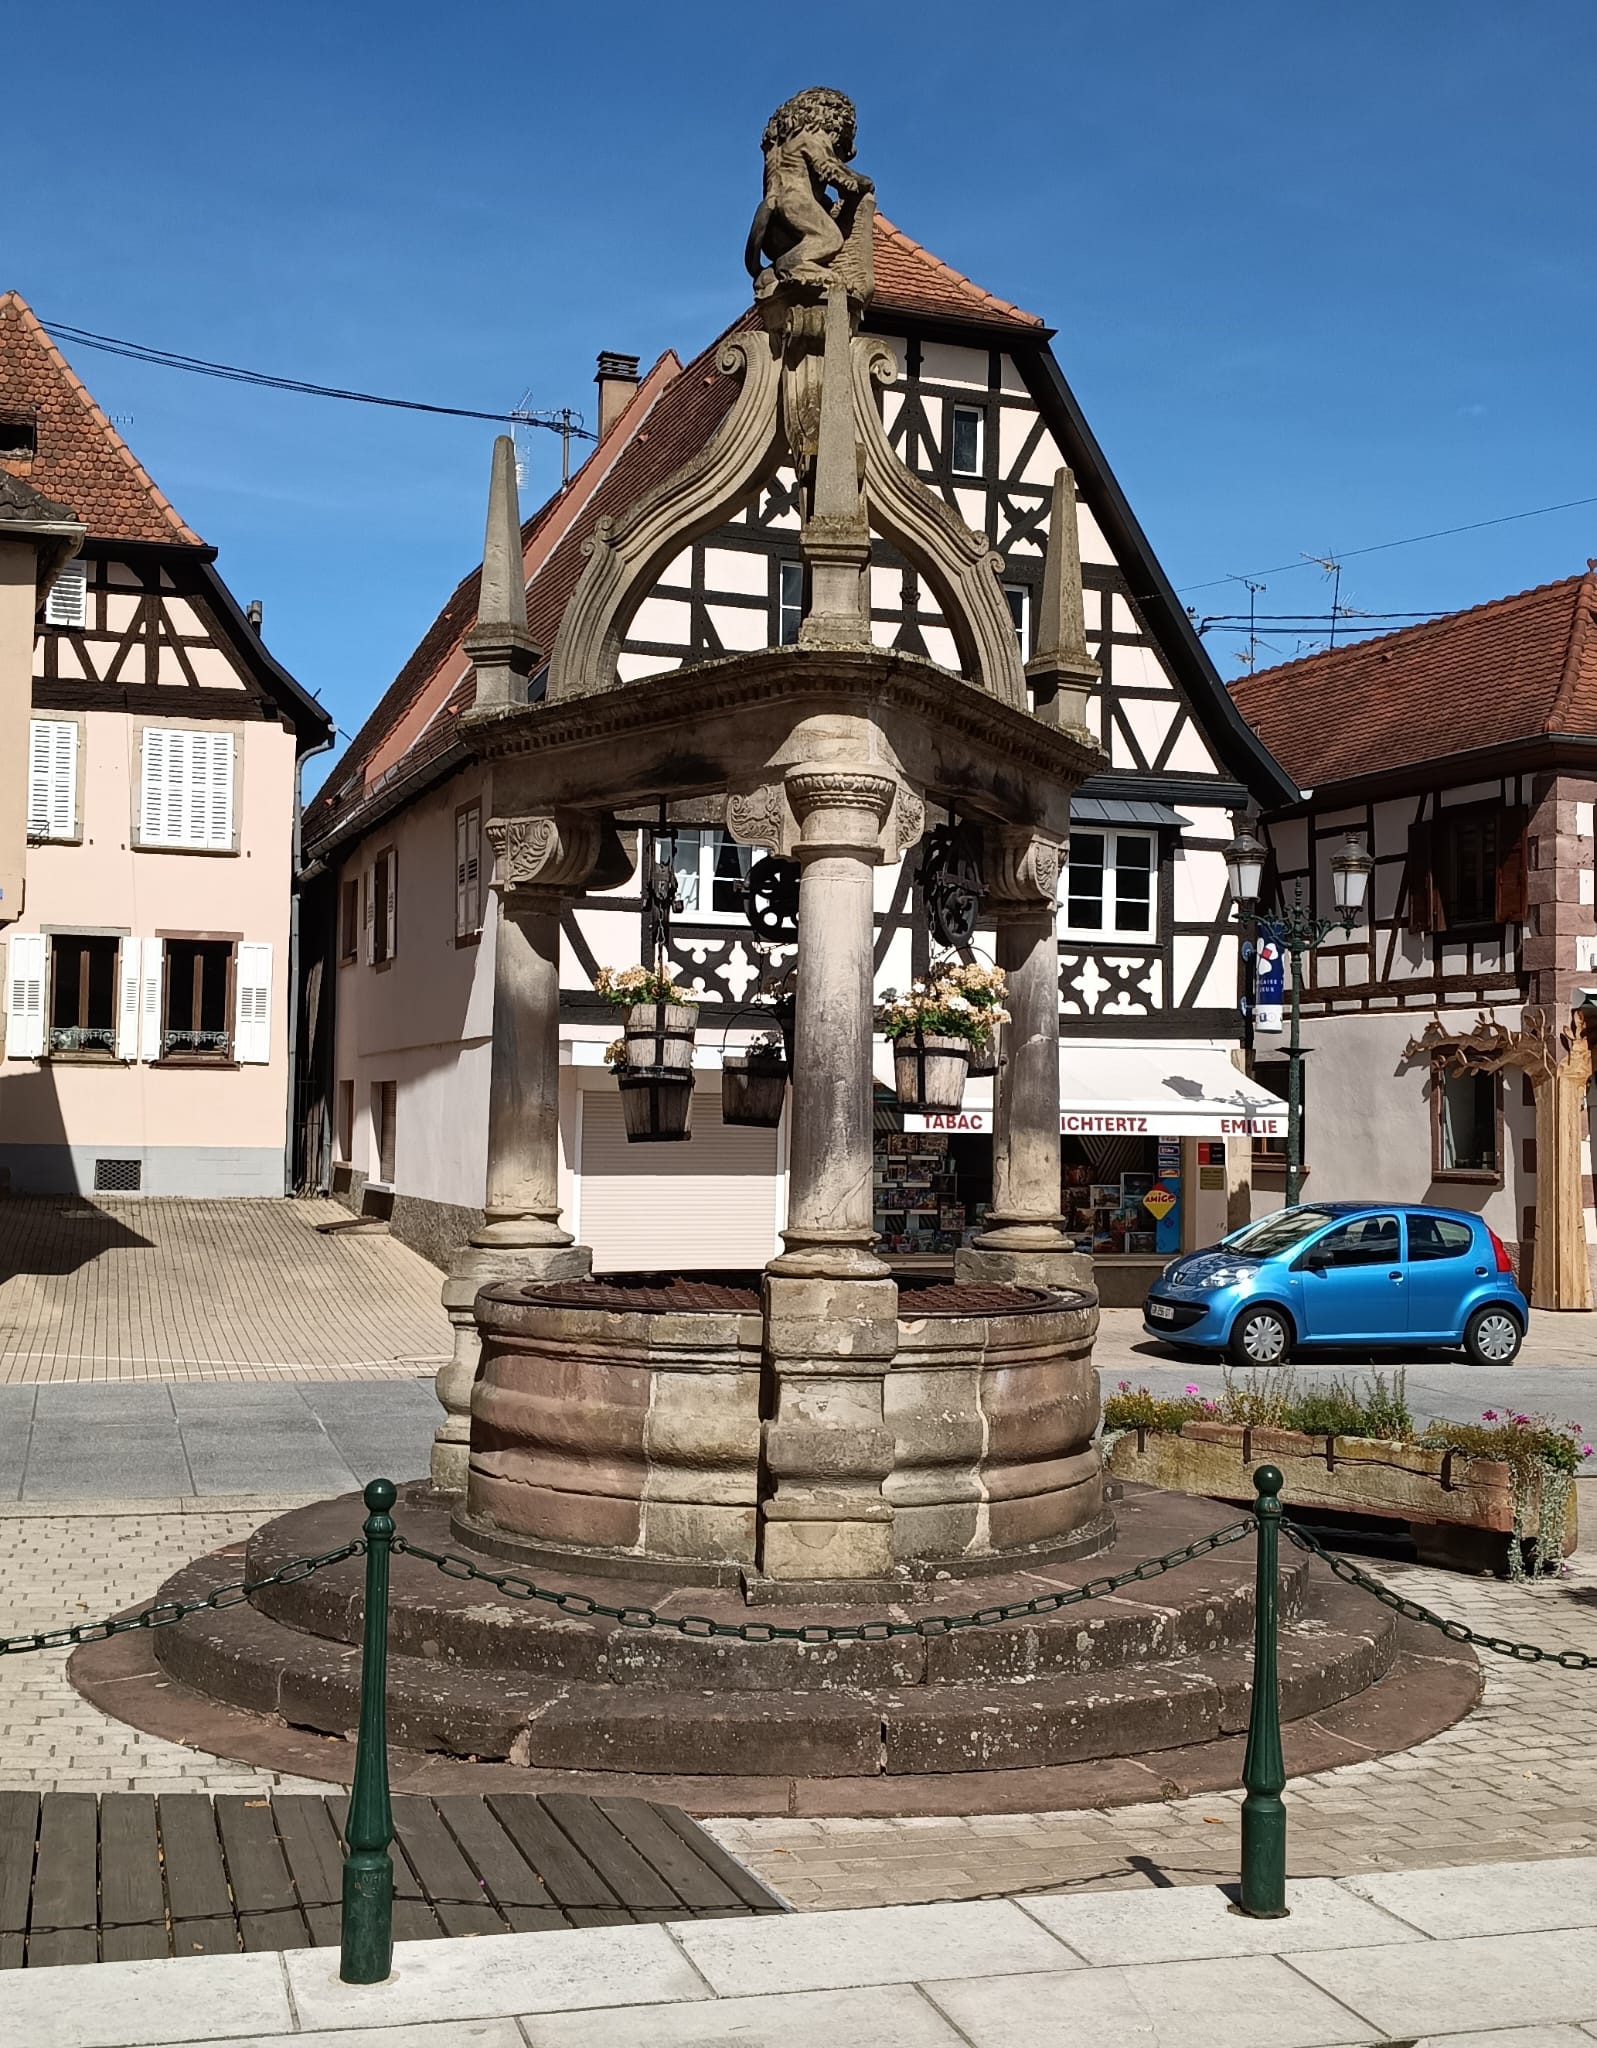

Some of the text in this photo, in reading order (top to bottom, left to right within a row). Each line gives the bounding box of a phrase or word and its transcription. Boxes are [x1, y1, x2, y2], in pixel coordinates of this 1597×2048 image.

[923, 1113, 1278, 1134] TABAC ICHTERTZ EMILIE
